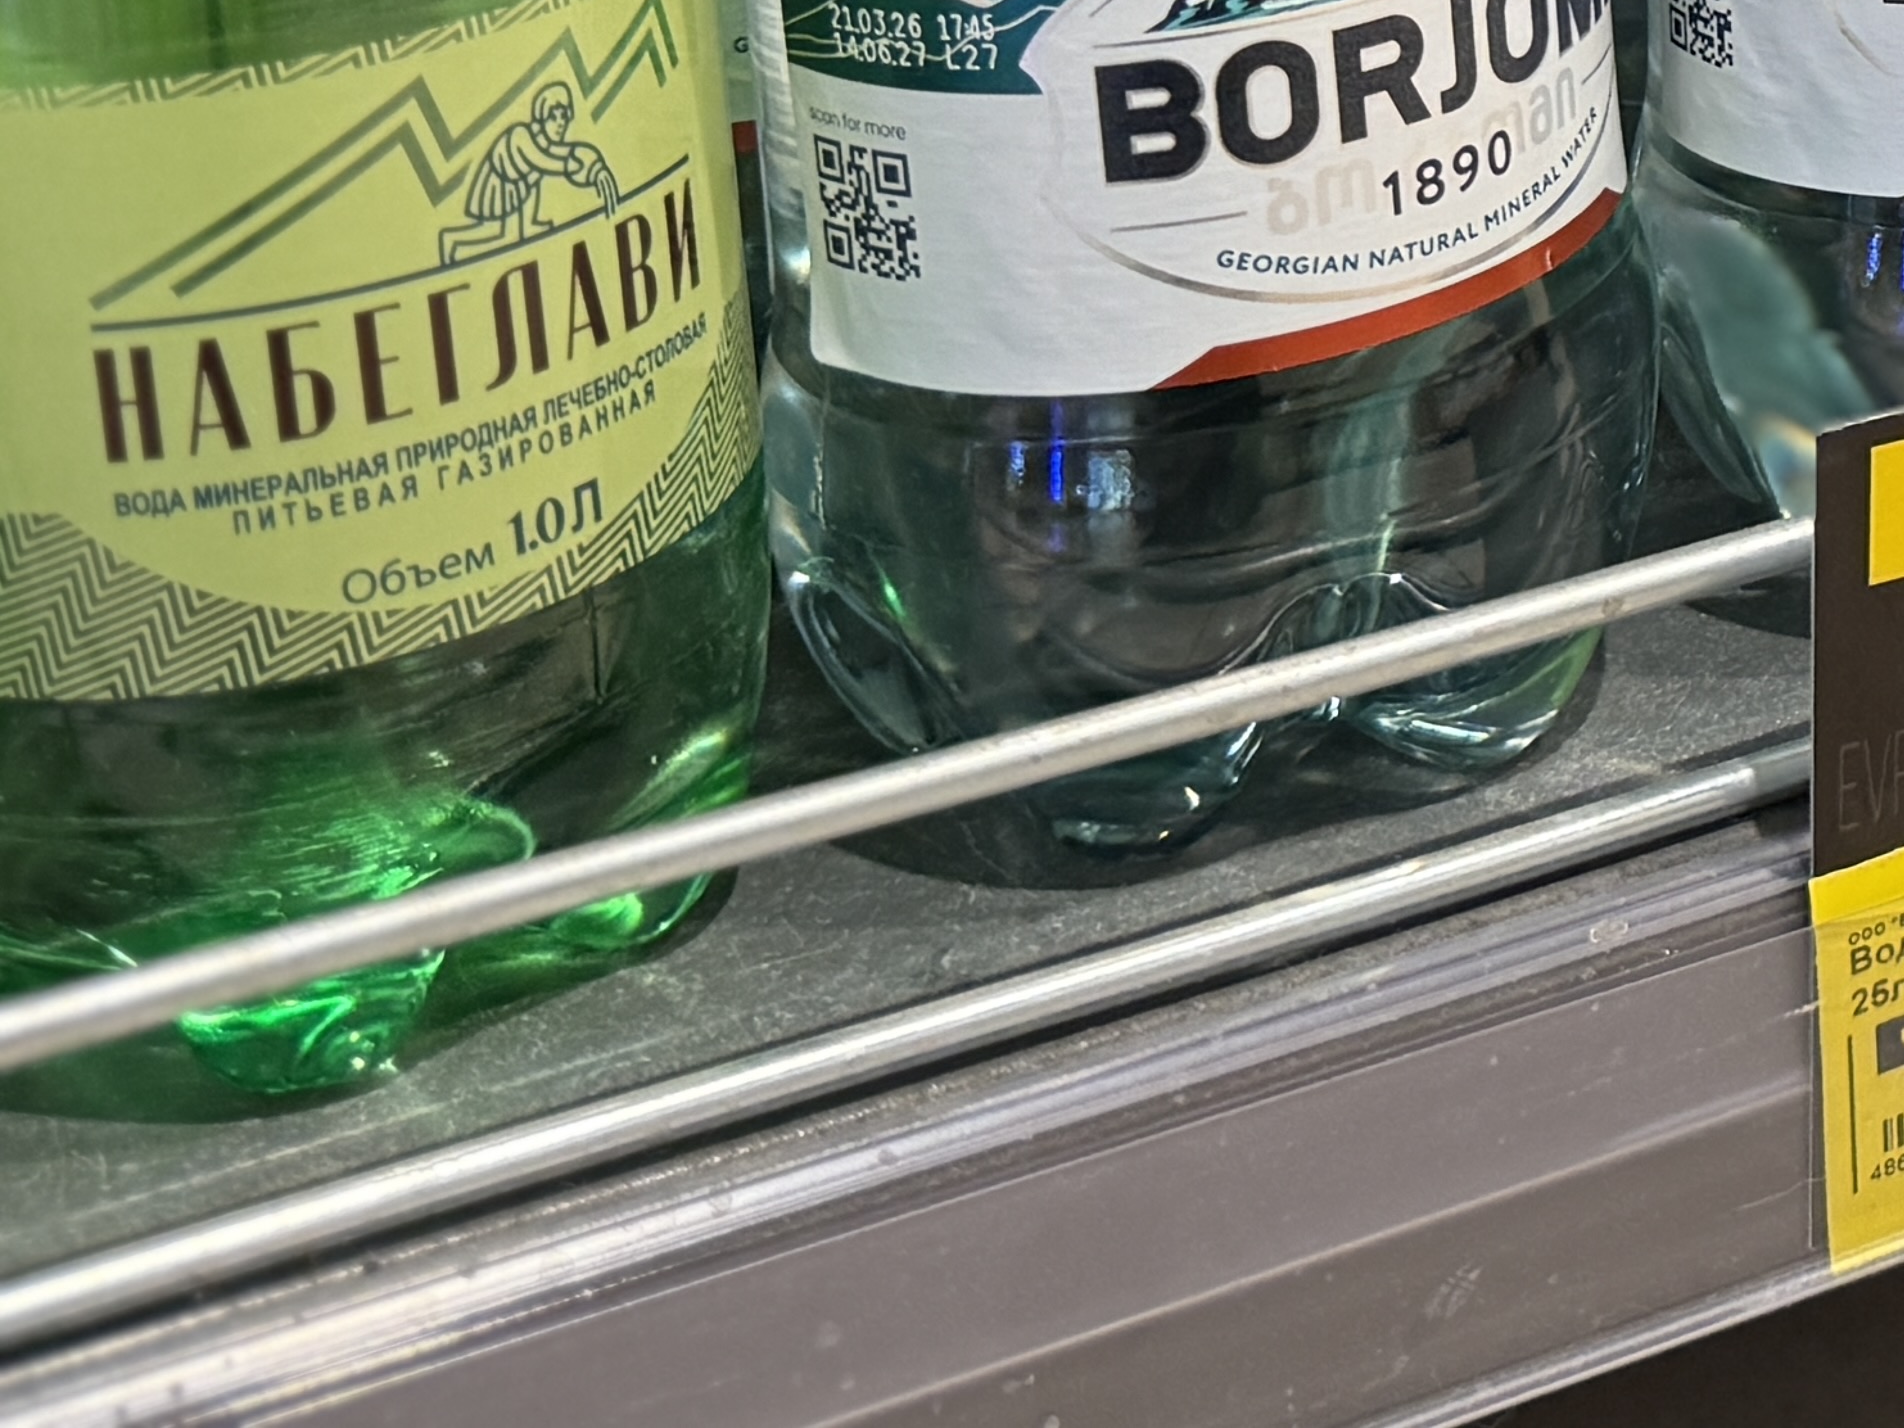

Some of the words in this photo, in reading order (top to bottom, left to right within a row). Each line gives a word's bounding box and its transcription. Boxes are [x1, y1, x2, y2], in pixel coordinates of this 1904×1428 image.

[829, 2, 922, 39] 21.03.26
[833, 31, 926, 68] 14.06.27
[944, 44, 998, 71] L27
[809, 105, 841, 128] scan
[841, 113, 861, 134] for
[864, 118, 907, 141] more
[1216, 247, 1359, 275] GEORGIAN
[1369, 221, 1479, 267] NATURAL
[1483, 165, 1561, 232] MINERAL
[1561, 105, 1598, 169] WATER
[1382, 129, 1512, 217] 1890
[92, 176, 702, 464] НАБЕГЛАВИ
[113, 488, 188, 518] ВОДА
[193, 451, 390, 510] МИНЕРАЛЬНАЯ
[395, 405, 539, 472] ПРИРОДНАЯ
[542, 312, 708, 425] ЛЕЧЕБНО-СТОЛОВАЯ
[232, 475, 419, 537] ПИТЬЕВАЯ
[437, 378, 657, 491] ГАЗИРОВАННАЯ
[341, 541, 496, 605] Объем
[1848, 921, 1886, 946] ООО
